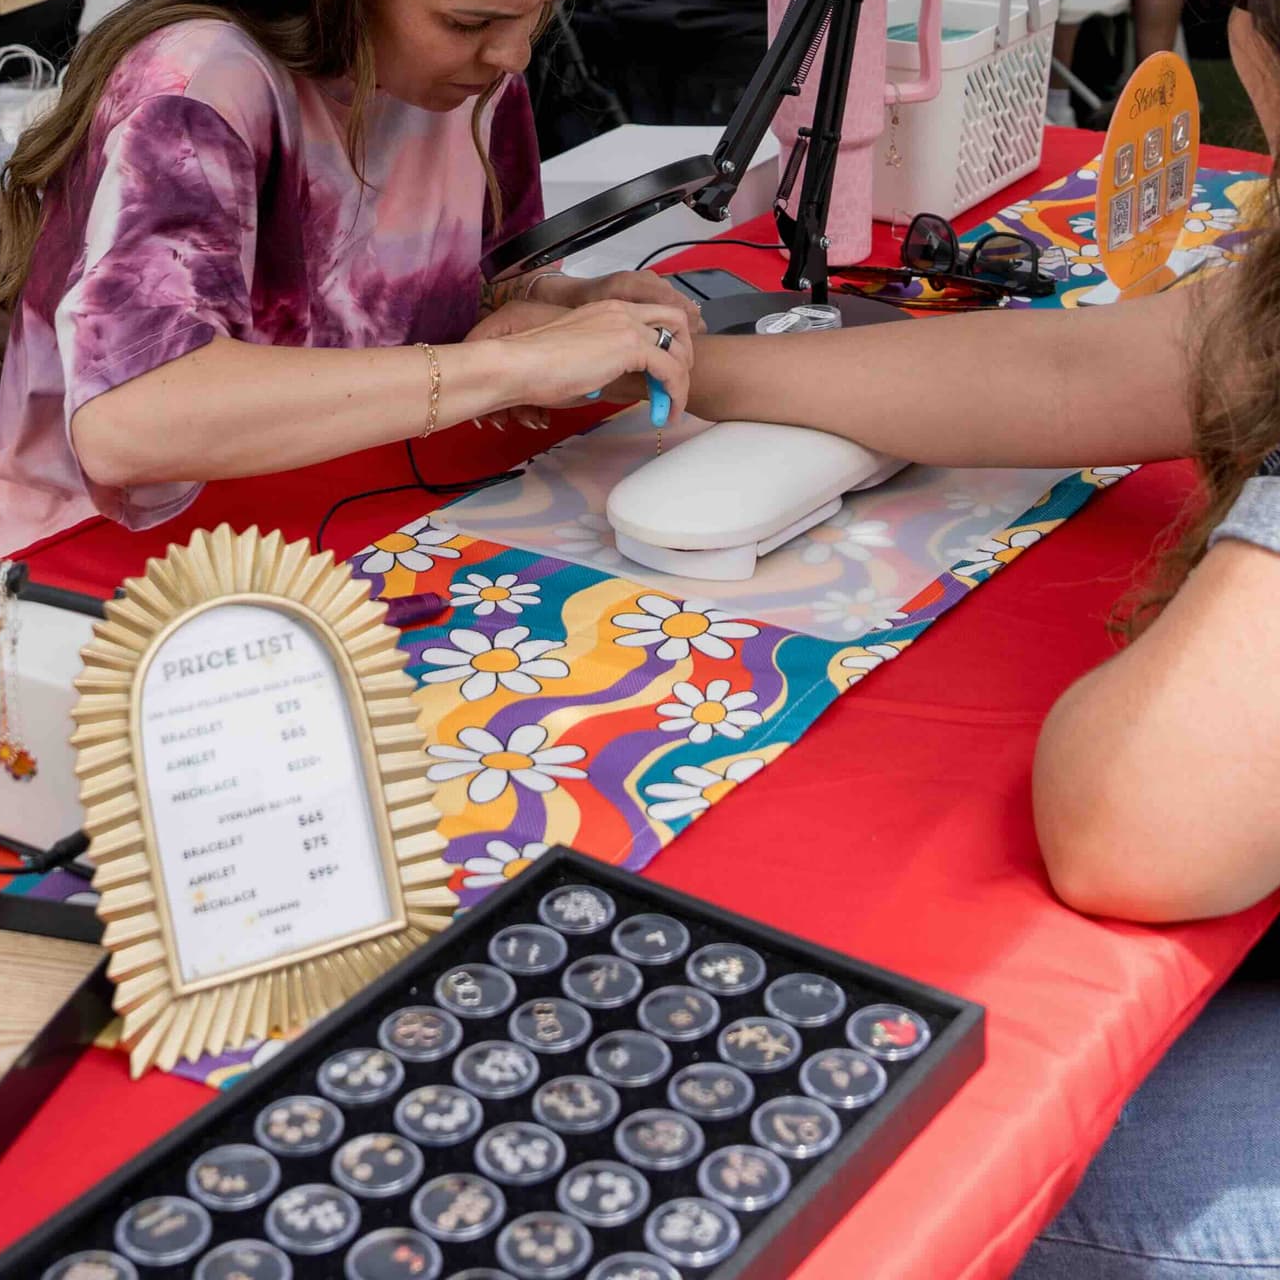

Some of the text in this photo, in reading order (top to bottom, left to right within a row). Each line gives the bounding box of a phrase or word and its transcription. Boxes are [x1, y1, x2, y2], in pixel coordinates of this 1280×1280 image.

[162, 631, 295, 681] PRICE LIST
[161, 720, 223, 746] BRACELET
[166, 748, 217, 772] ANKLET
[171, 775, 239, 803] NECKLACE
[182, 833, 243, 860] BRACELET
[303, 833, 329, 851] $75
[188, 864, 236, 887] ANKLET
[192, 887, 257, 915] NECKLACE
